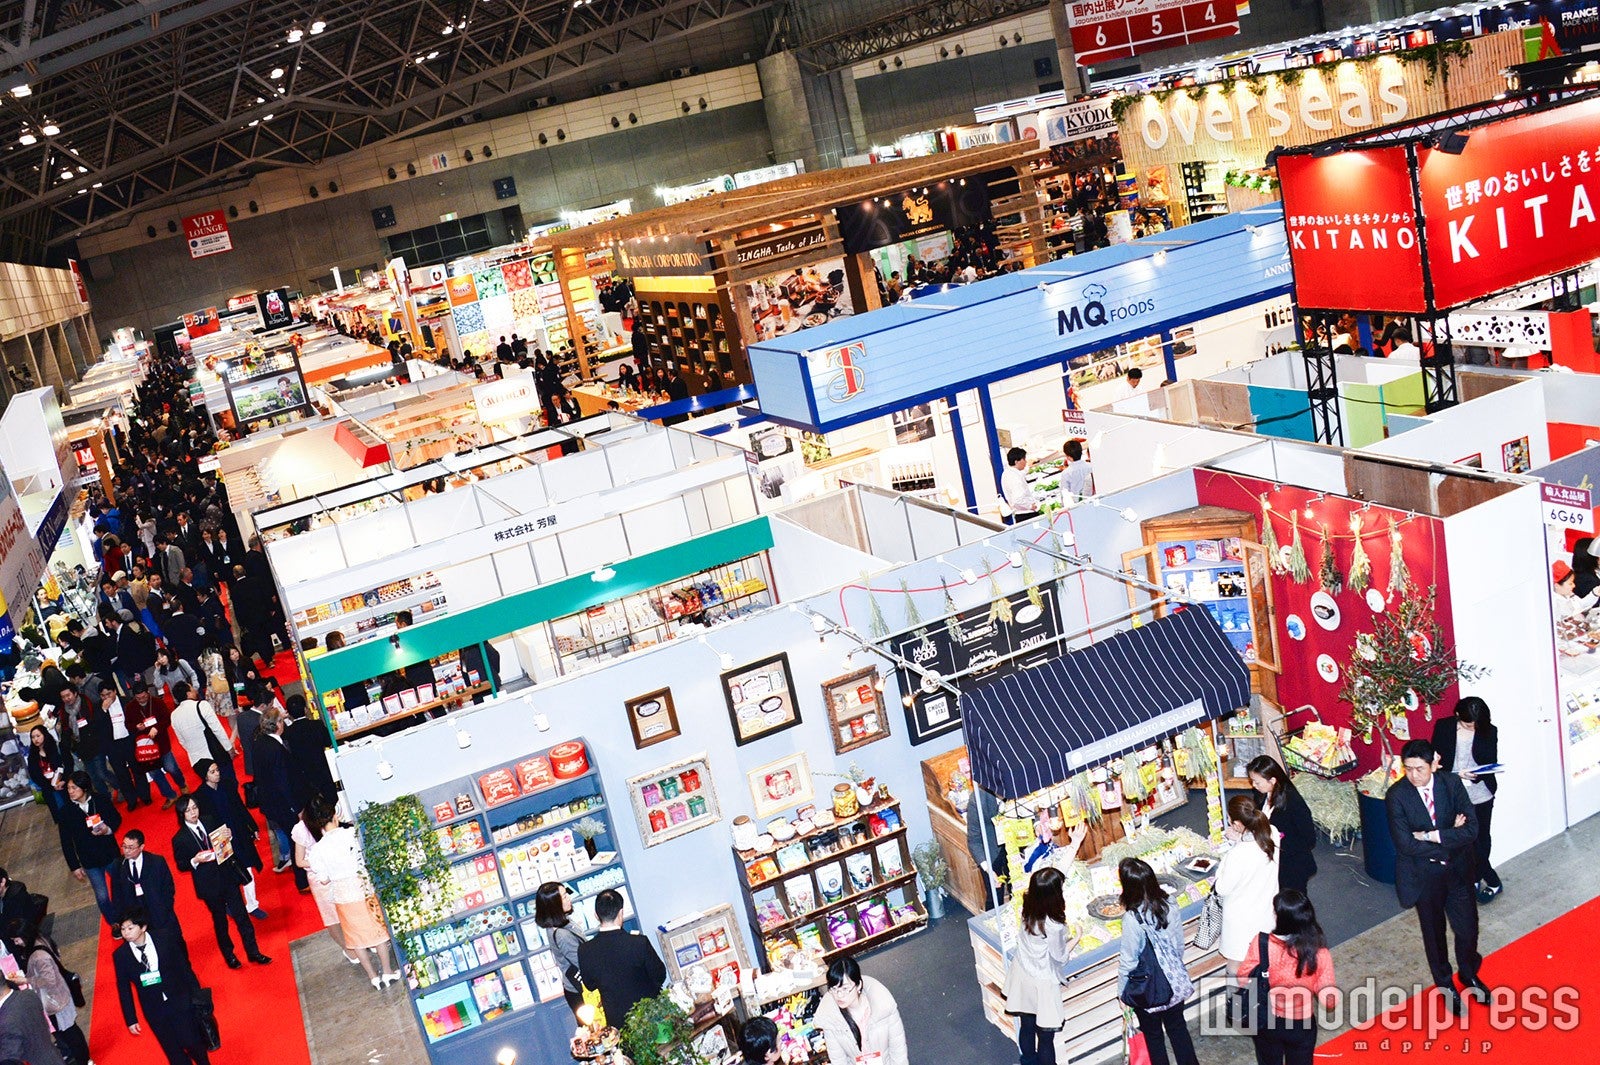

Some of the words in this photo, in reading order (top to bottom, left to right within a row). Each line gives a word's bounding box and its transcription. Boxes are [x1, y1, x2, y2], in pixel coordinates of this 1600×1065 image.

[1075, 15, 1104, 25] Japanese
[1105, 9, 1134, 19] Exhibition
[1134, 6, 1149, 14] Zone
[1561, 7, 1599, 21] FRANCE
[1095, 25, 1107, 46] 6
[1151, 14, 1163, 35] 5
[1204, 3, 1217, 24] 4
[1141, 79, 1410, 150] overseas
[192, 214, 215, 228] VIP
[1289, 211, 1411, 227] 世界のおいしさをキタノから
[1448, 183, 1597, 264] KITA
[188, 223, 225, 238] LOUNGE
[1291, 227, 1415, 250] KITANO
[775, 242, 796, 253] Taste
[798, 239, 806, 248] of
[629, 255, 652, 269] SINGHA
[653, 251, 702, 268] CORPORATION
[1057, 300, 1109, 336] MQ
[1110, 298, 1155, 322] FOODS
[1550, 508, 1584, 525] 6G69
[494, 521, 535, 542] 株式会社
[912, 641, 936, 656] MADE
[1019, 631, 1048, 650] EMILY
[913, 650, 938, 664] GOOD
